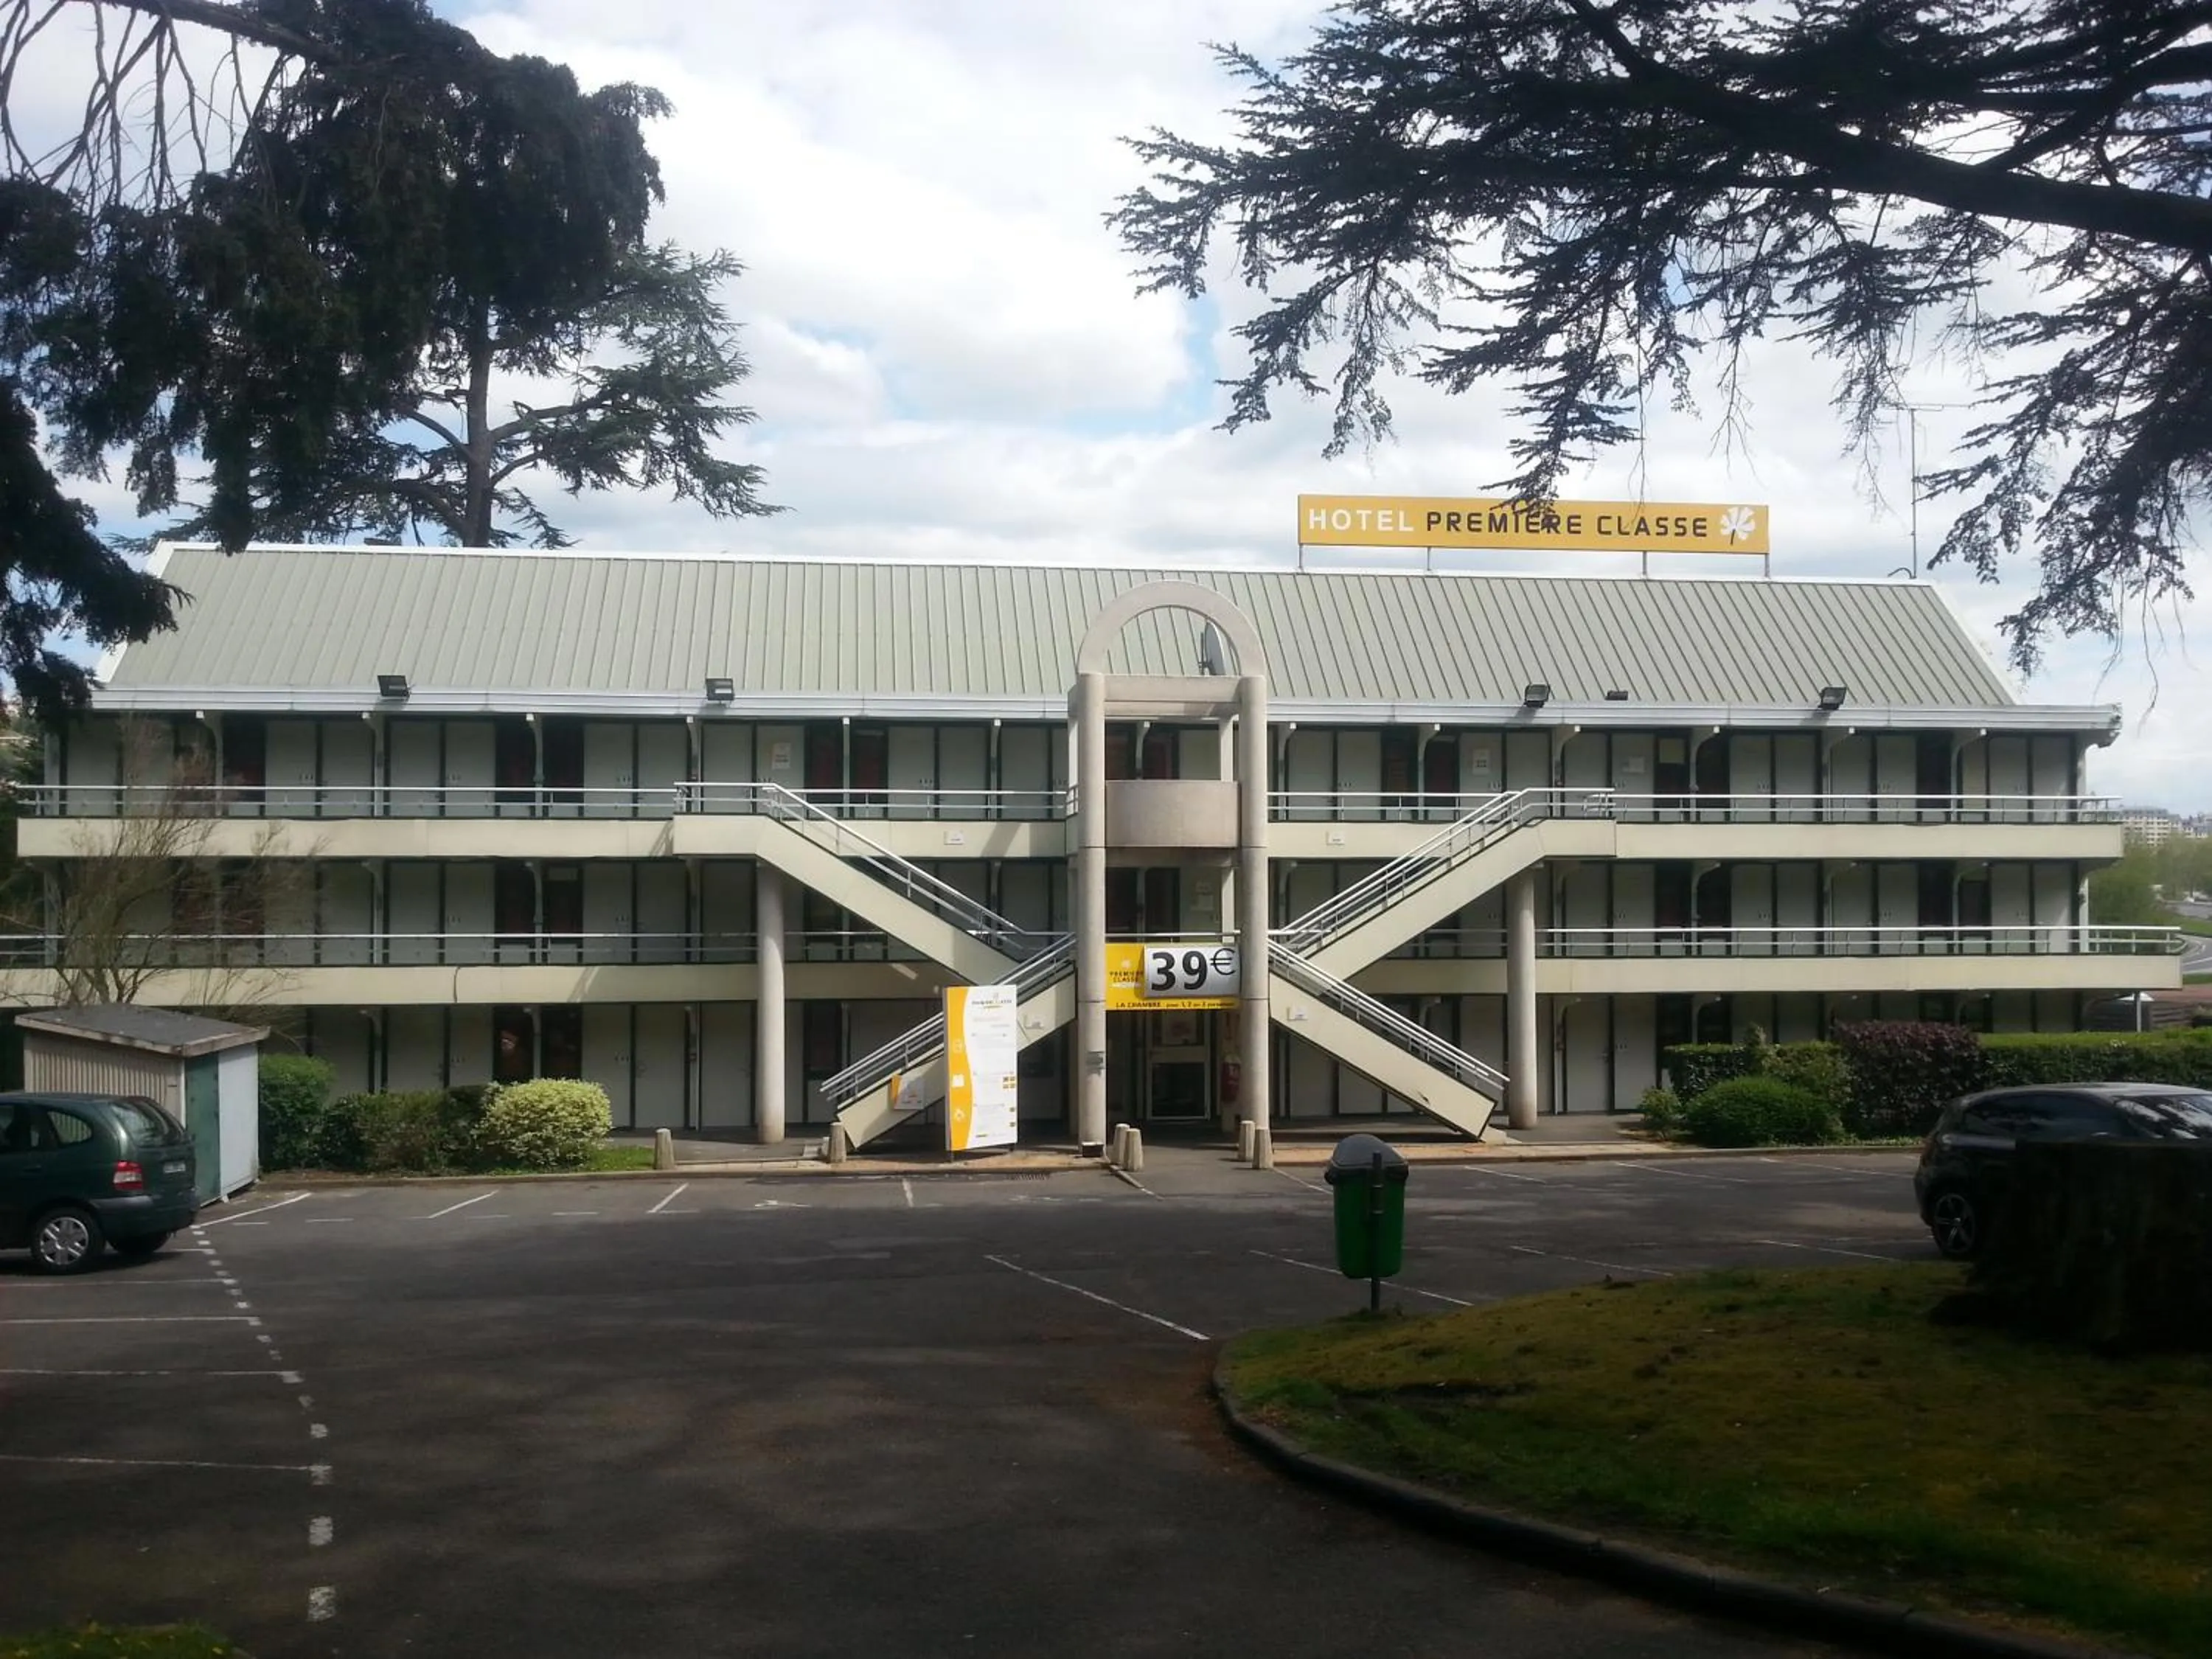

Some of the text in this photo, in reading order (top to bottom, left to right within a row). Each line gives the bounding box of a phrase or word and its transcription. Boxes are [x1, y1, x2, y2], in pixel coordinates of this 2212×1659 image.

[1308, 508, 1415, 532] HOTEL
[1596, 515, 1708, 538] CLASSE
[1150, 947, 1237, 992] 39€
